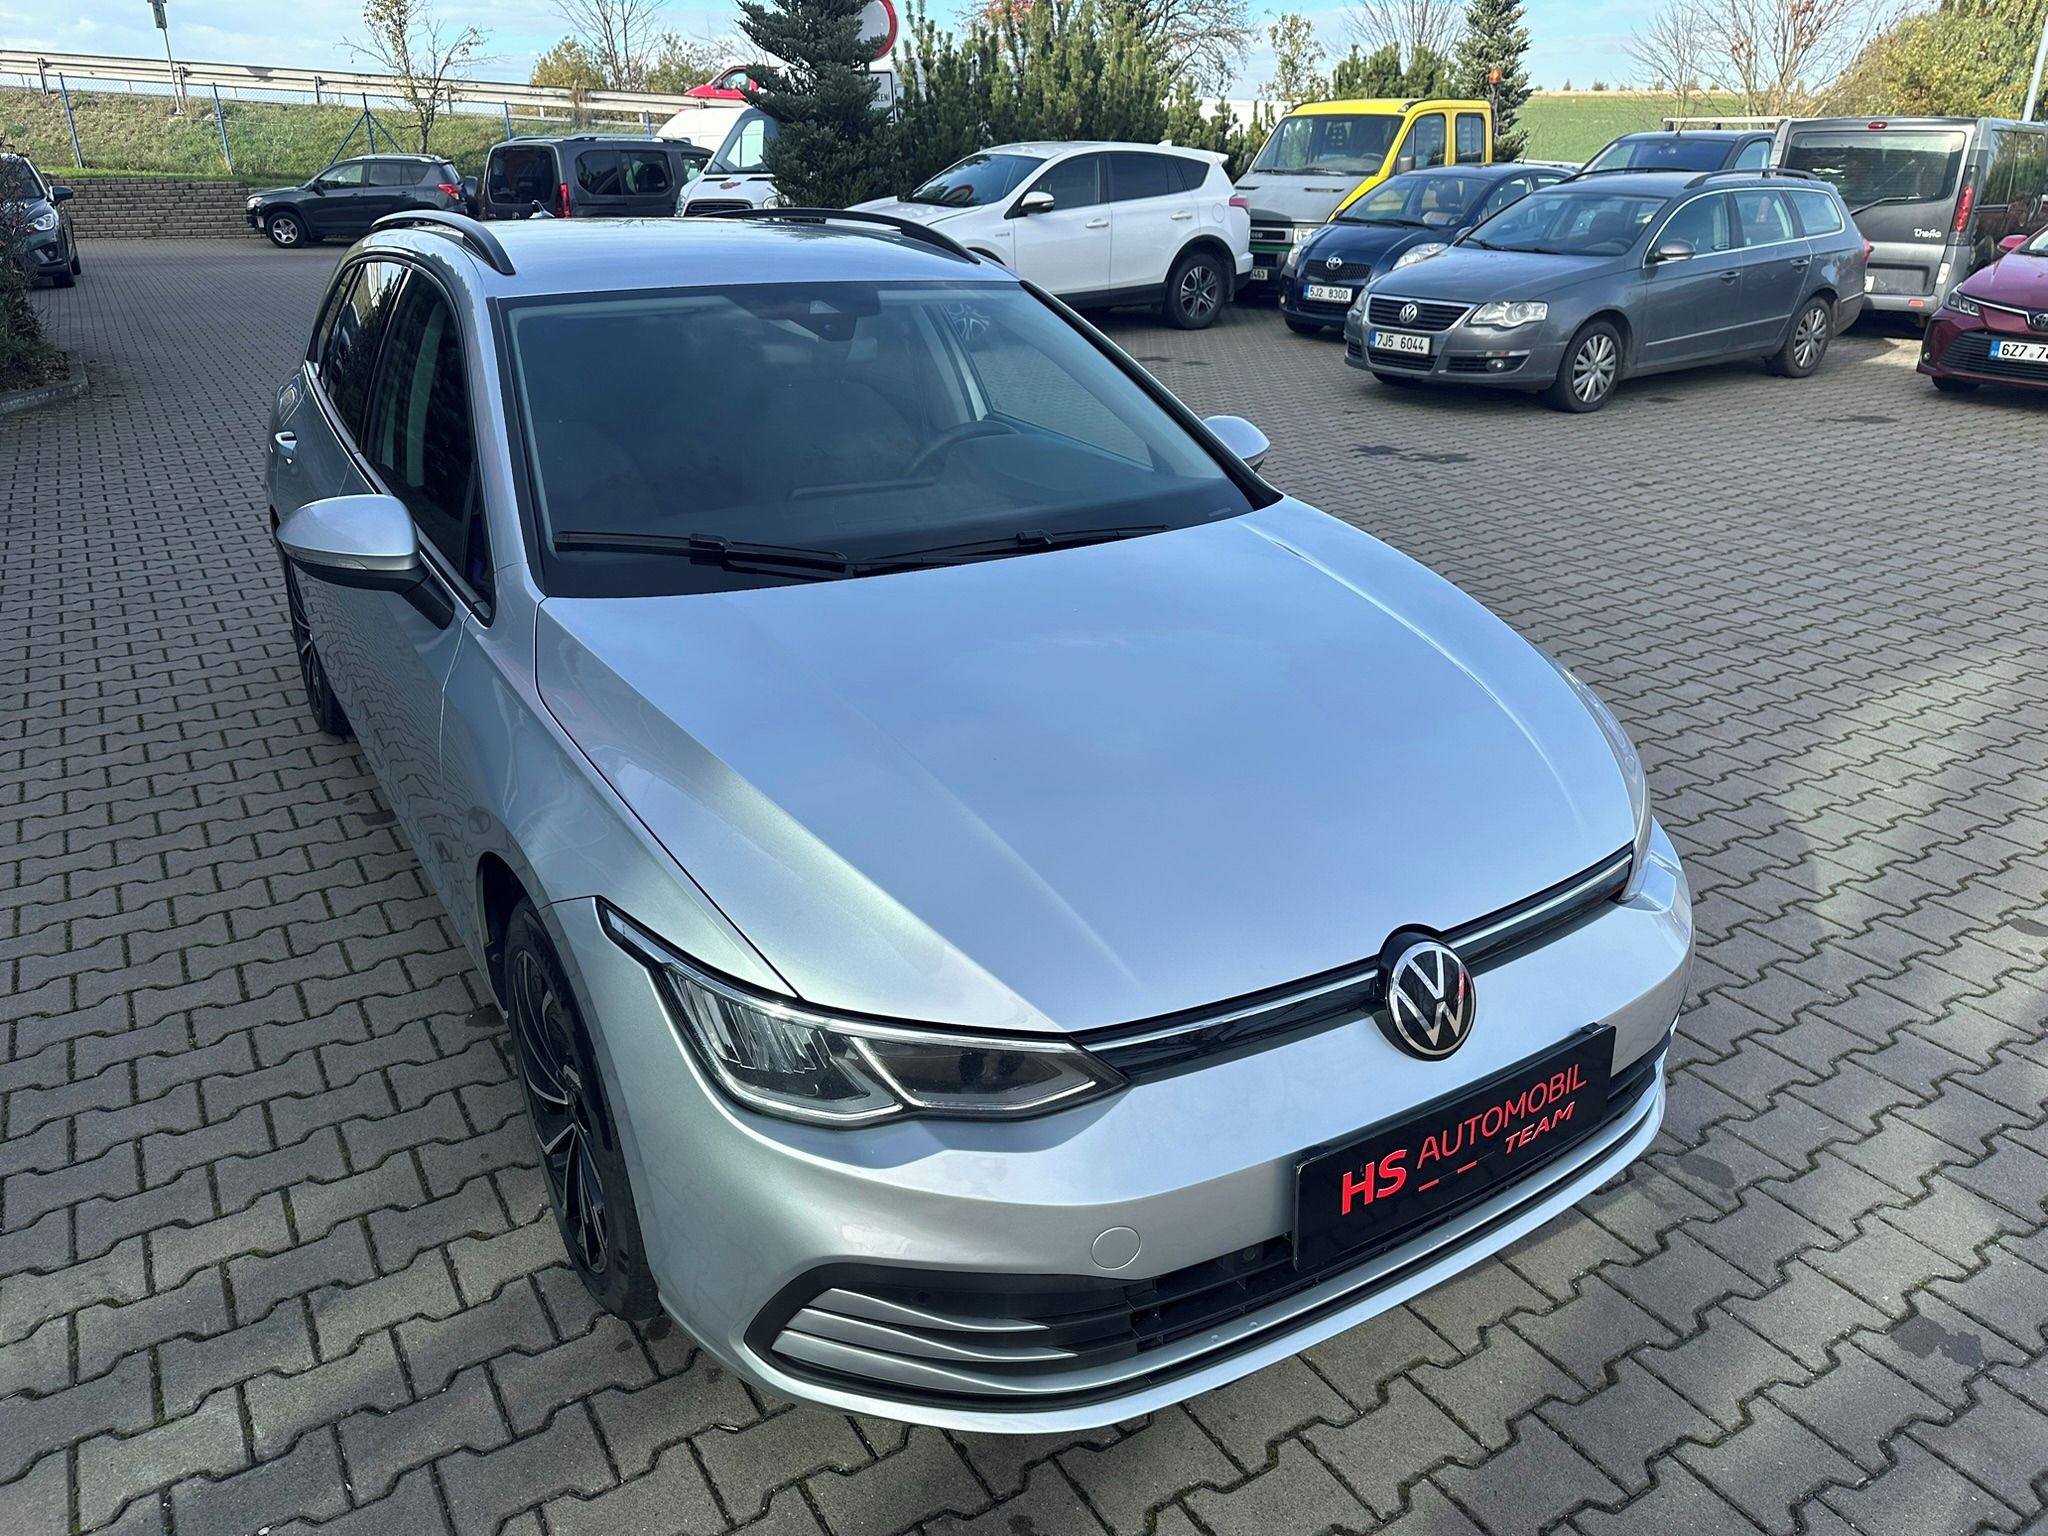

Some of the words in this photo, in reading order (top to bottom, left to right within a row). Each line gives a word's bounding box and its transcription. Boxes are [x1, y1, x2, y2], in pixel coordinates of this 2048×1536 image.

[1310, 286, 1324, 298] 5J2
[1328, 288, 1349, 300] 8300
[1377, 333, 1394, 348] 7J5
[1400, 336, 1424, 351] 6044
[2001, 343, 2028, 357] 6Z7
[2037, 346, 2048, 359] 7
[1505, 1100, 1576, 1154] TEAM
[1341, 1149, 1408, 1216] HS
[1416, 1063, 1587, 1170] AUTOMOBIL
